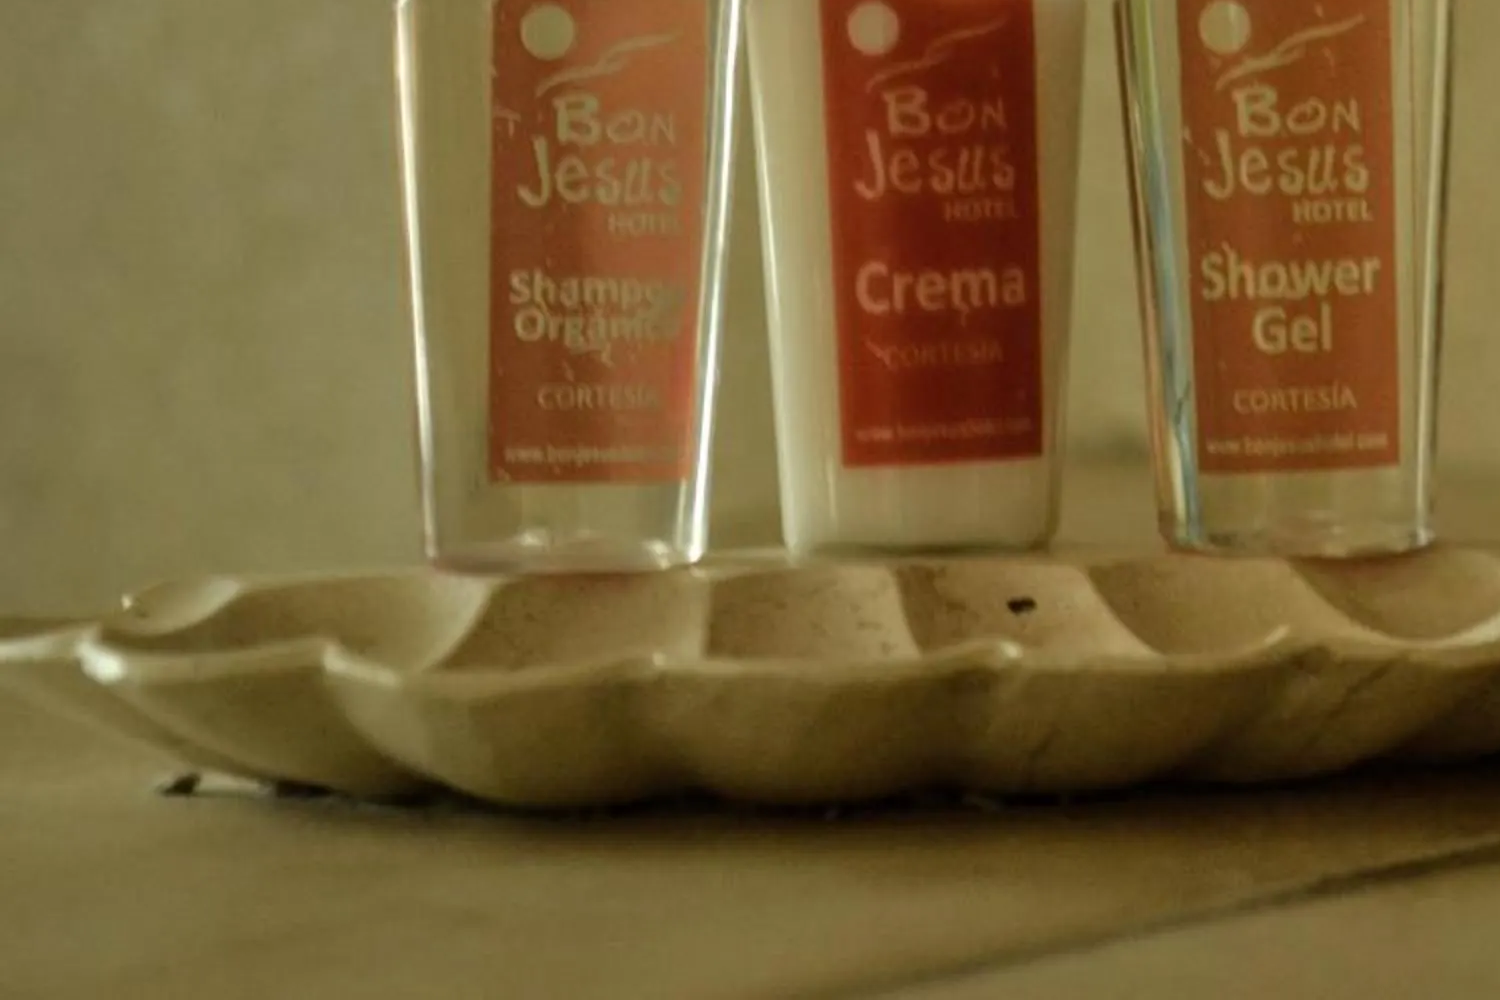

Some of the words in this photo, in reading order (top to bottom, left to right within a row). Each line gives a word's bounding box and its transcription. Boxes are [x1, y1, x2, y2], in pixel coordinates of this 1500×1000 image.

[553, 93, 676, 146] BON
[884, 84, 1008, 137] BON
[1231, 82, 1362, 138] BON
[1292, 198, 1373, 224] HOTEL
[855, 260, 1027, 315] Crema
[1200, 250, 1382, 301] Shower
[1251, 301, 1334, 357] Gel
